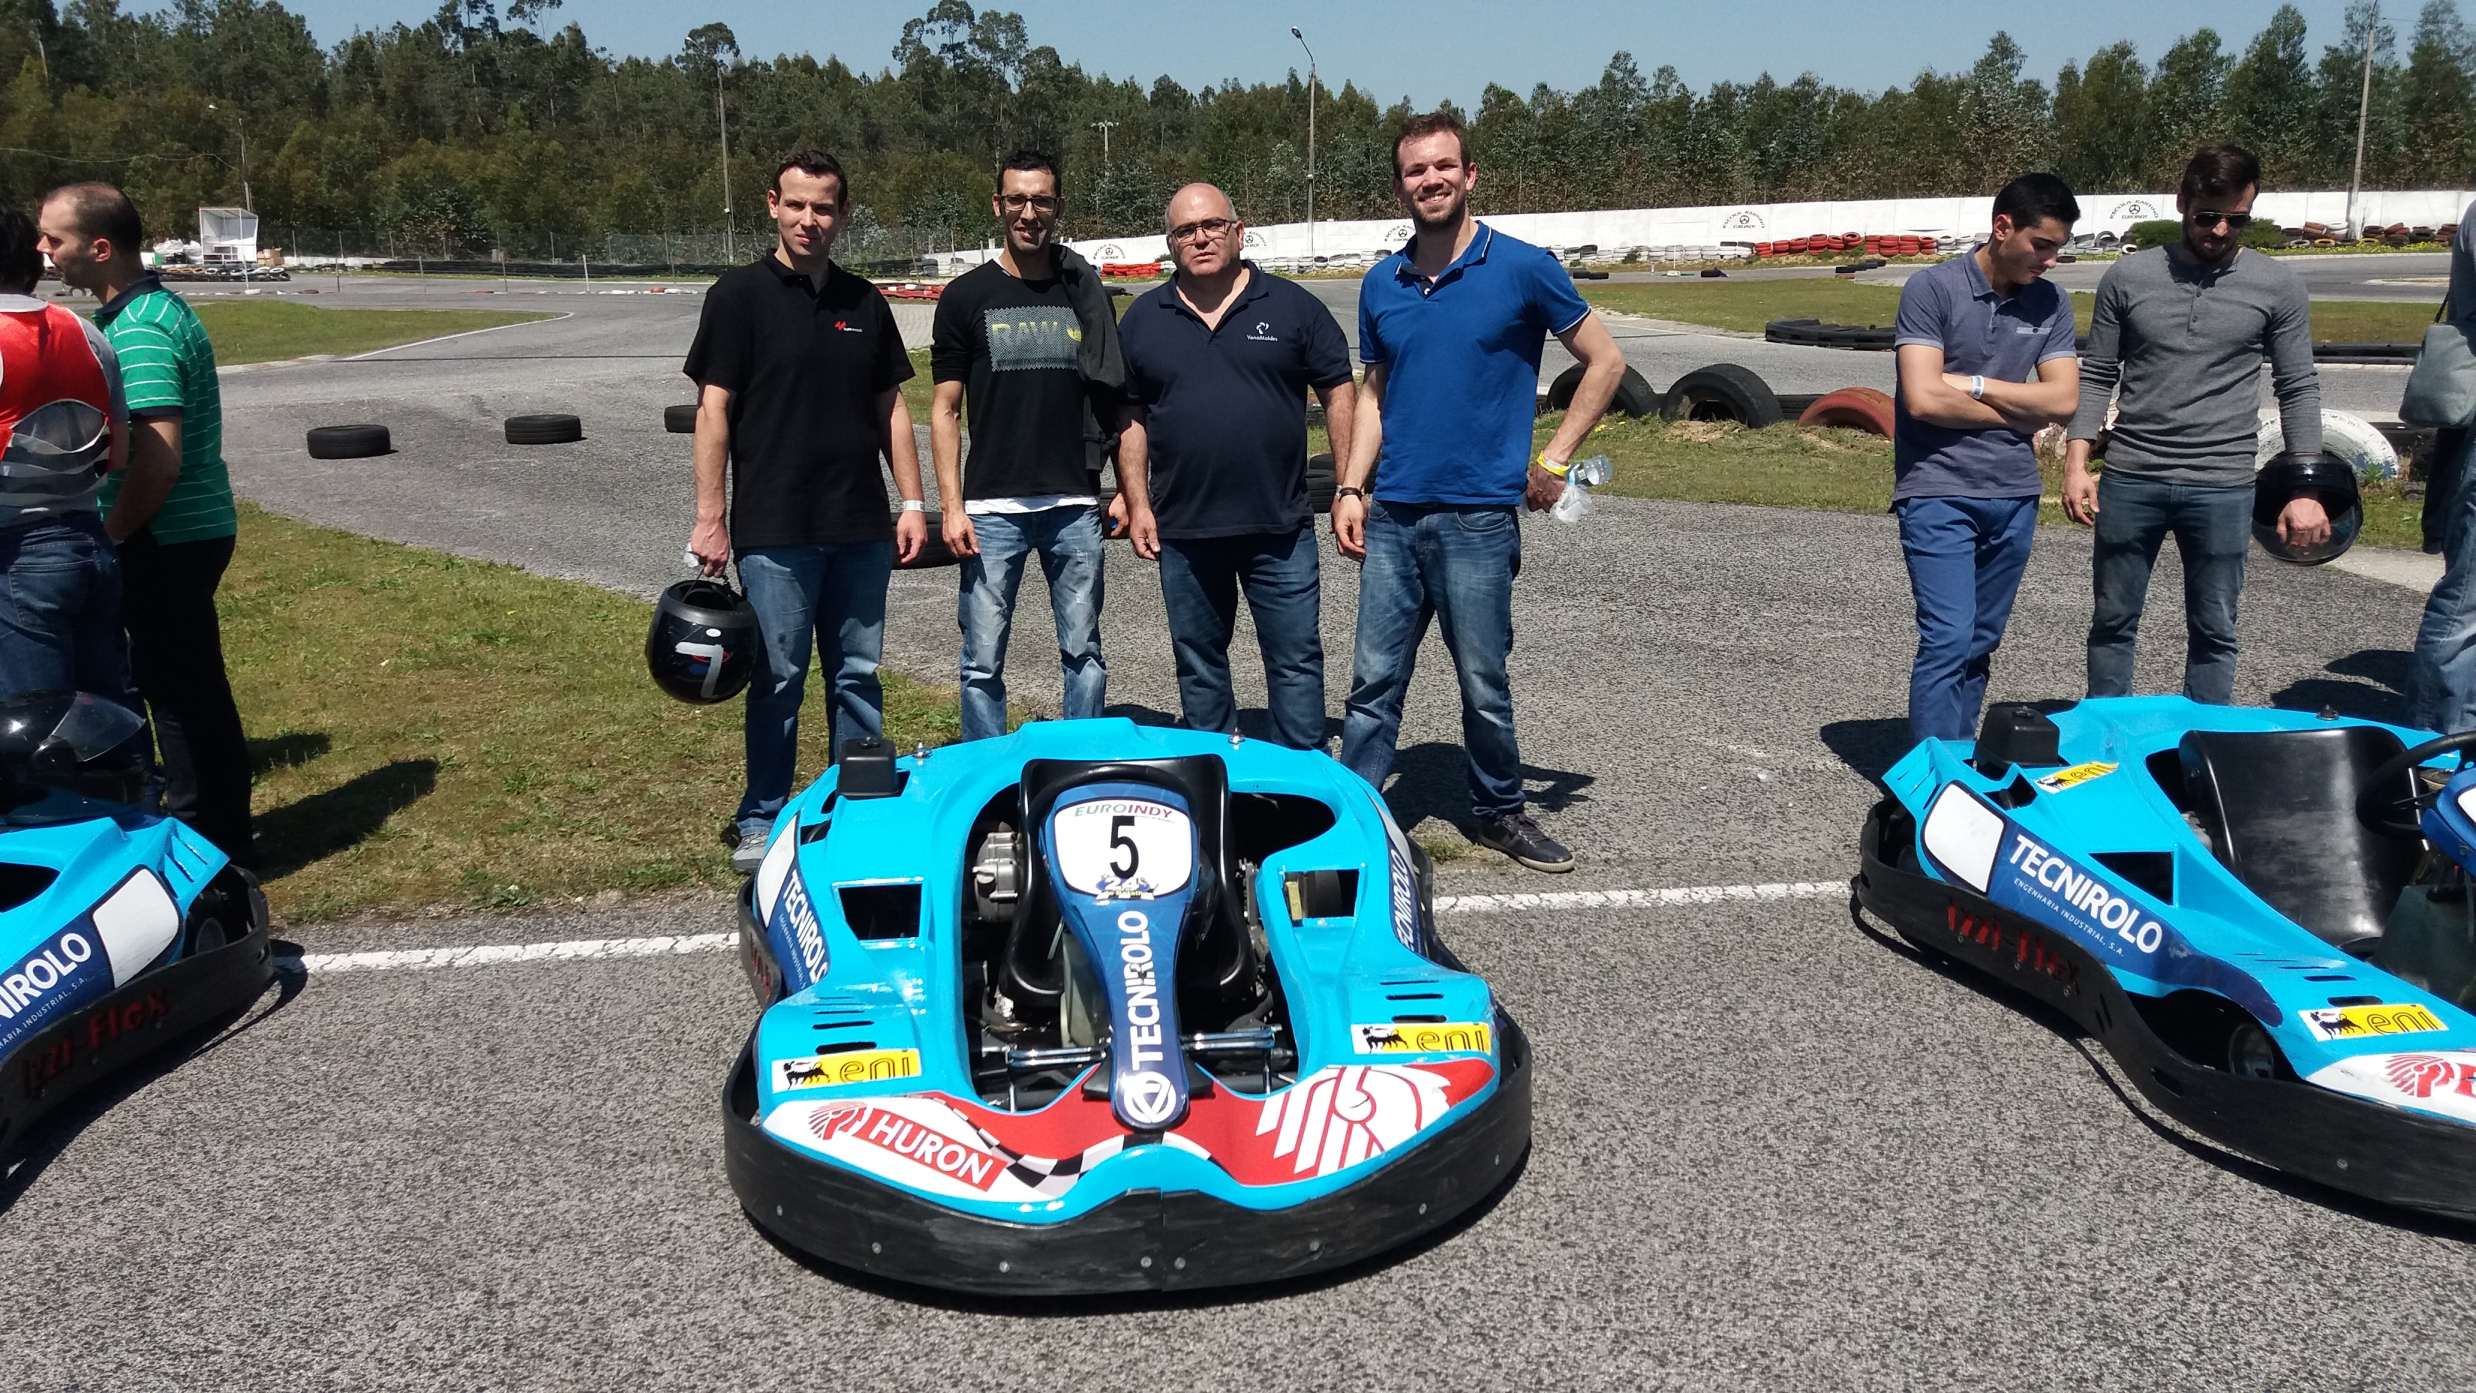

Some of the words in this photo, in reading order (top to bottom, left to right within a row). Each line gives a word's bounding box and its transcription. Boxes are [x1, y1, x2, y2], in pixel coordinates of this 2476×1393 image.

[1074, 803, 1173, 818] EUROINDY
[1110, 815, 1140, 880] 5
[2009, 833, 2163, 955] TECNIROLO
[2013, 877, 2060, 912] ENGENHARIA
[2060, 909, 2107, 947] INDUSTRIAL,
[2108, 942, 2125, 958] S.A.
[1117, 910, 1165, 1071] TECNIROLO
[2366, 1003, 2438, 1035] eni
[839, 1049, 911, 1084] eni
[1416, 1022, 1486, 1053] eni
[868, 1115, 995, 1185] HURON
